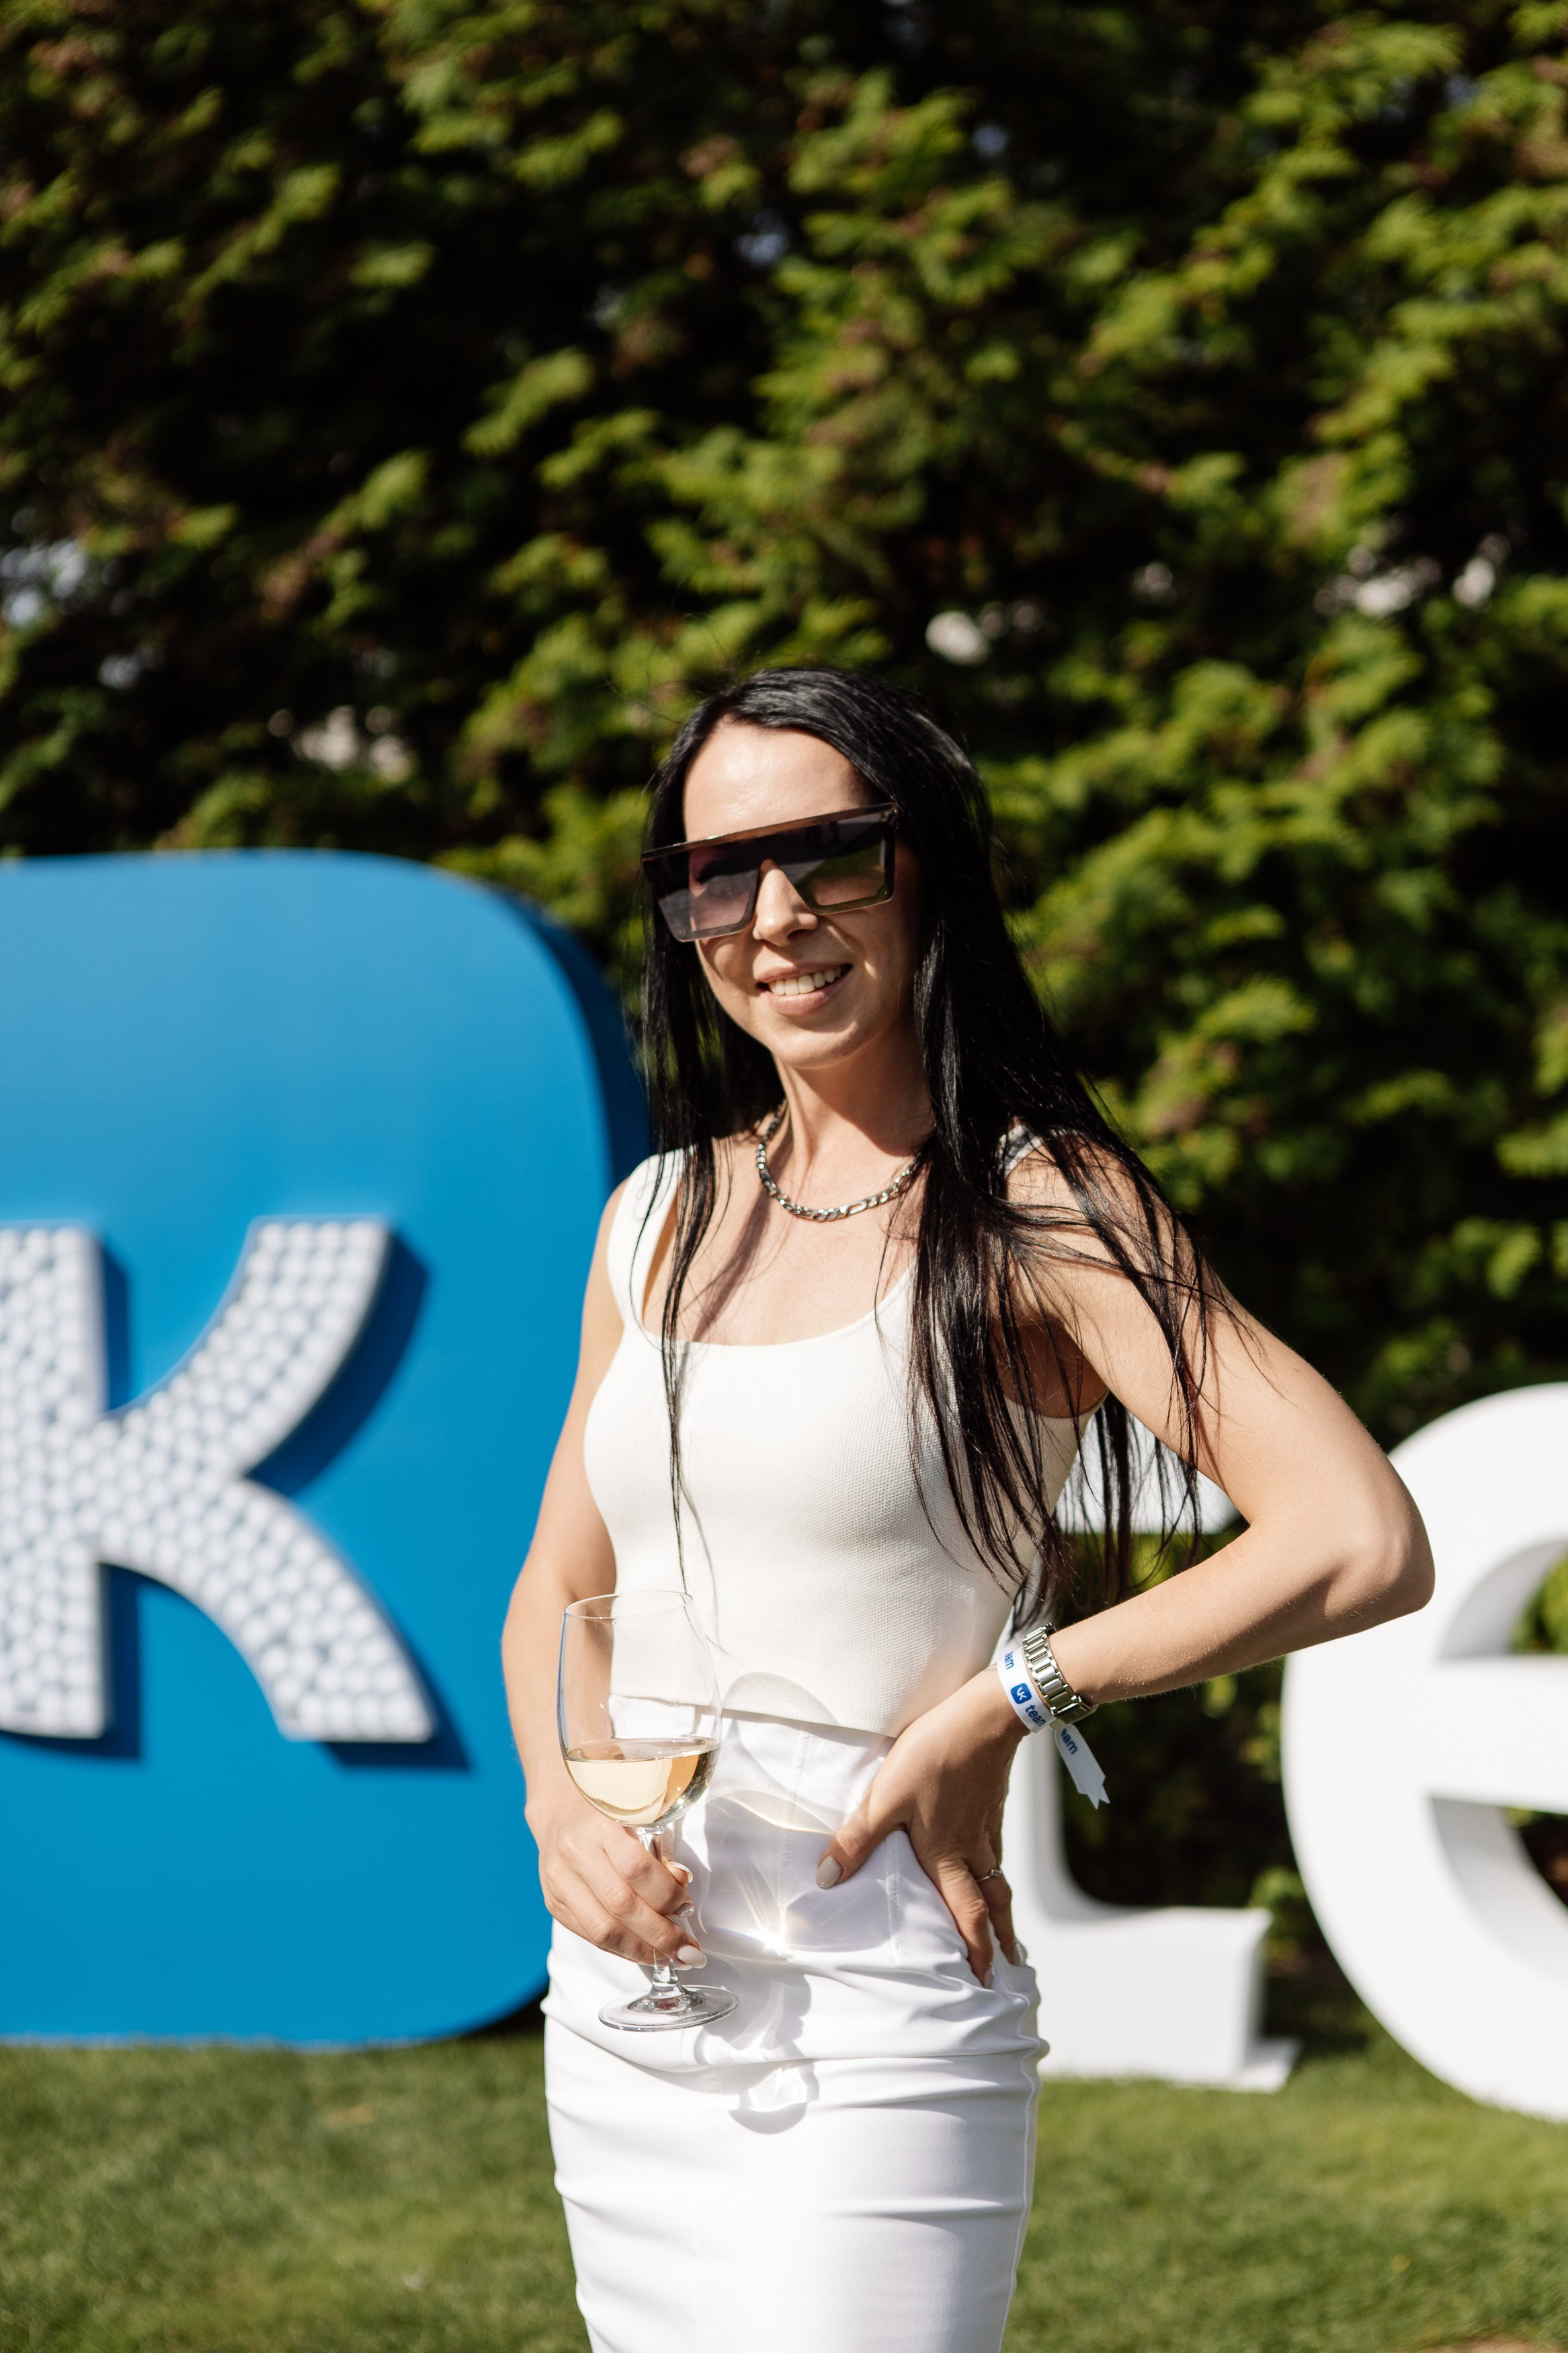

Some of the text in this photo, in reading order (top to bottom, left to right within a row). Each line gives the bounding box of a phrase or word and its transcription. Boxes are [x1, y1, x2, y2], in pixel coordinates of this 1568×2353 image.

[0, 1214, 436, 1741] K
[1004, 1651, 1014, 1670] eam
[1025, 1704, 1047, 1727] team
[1061, 1728, 1078, 1755] eam
